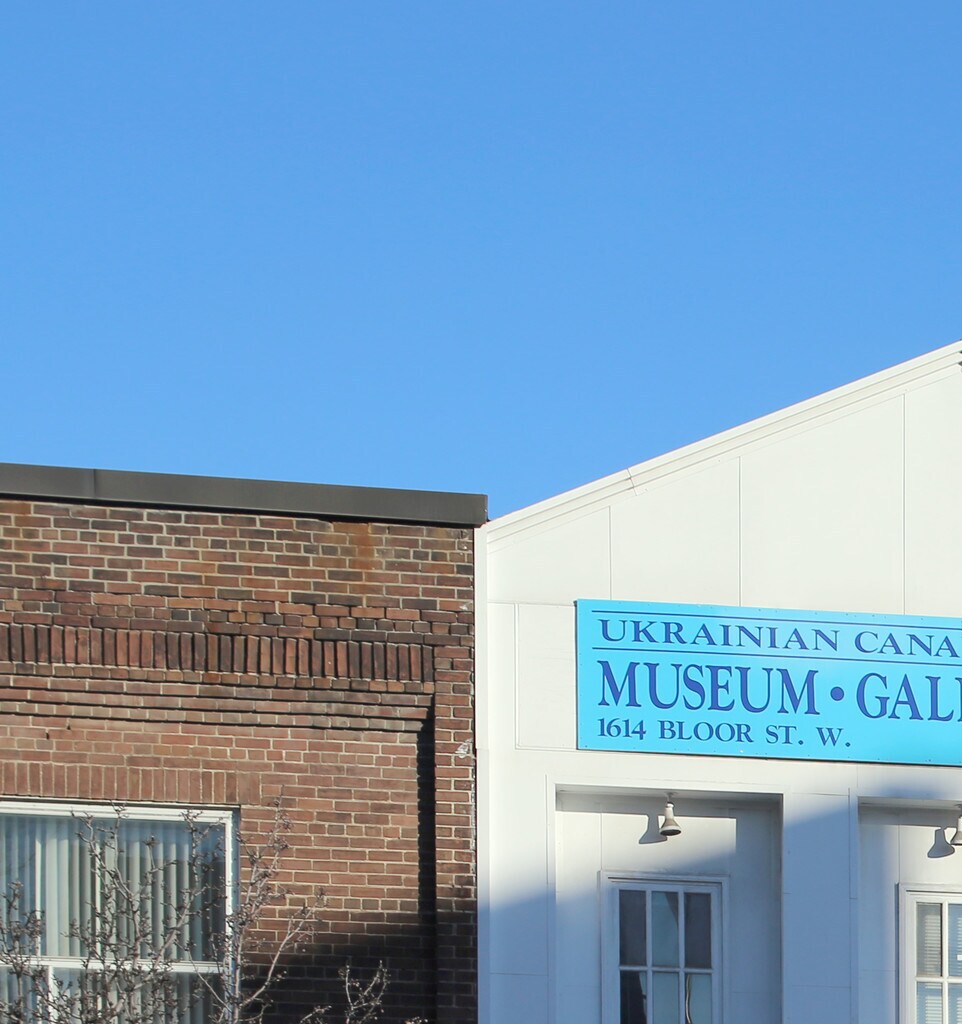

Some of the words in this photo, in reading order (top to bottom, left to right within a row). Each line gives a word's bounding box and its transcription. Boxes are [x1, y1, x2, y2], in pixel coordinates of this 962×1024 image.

[599, 619, 840, 651] UKRAINIAN
[597, 660, 820, 715] MUSEUM
[597, 717, 646, 741] 1614
[658, 719, 754, 743] BLOOR
[765, 724, 804, 745] ST.
[816, 727, 851, 747] W.
